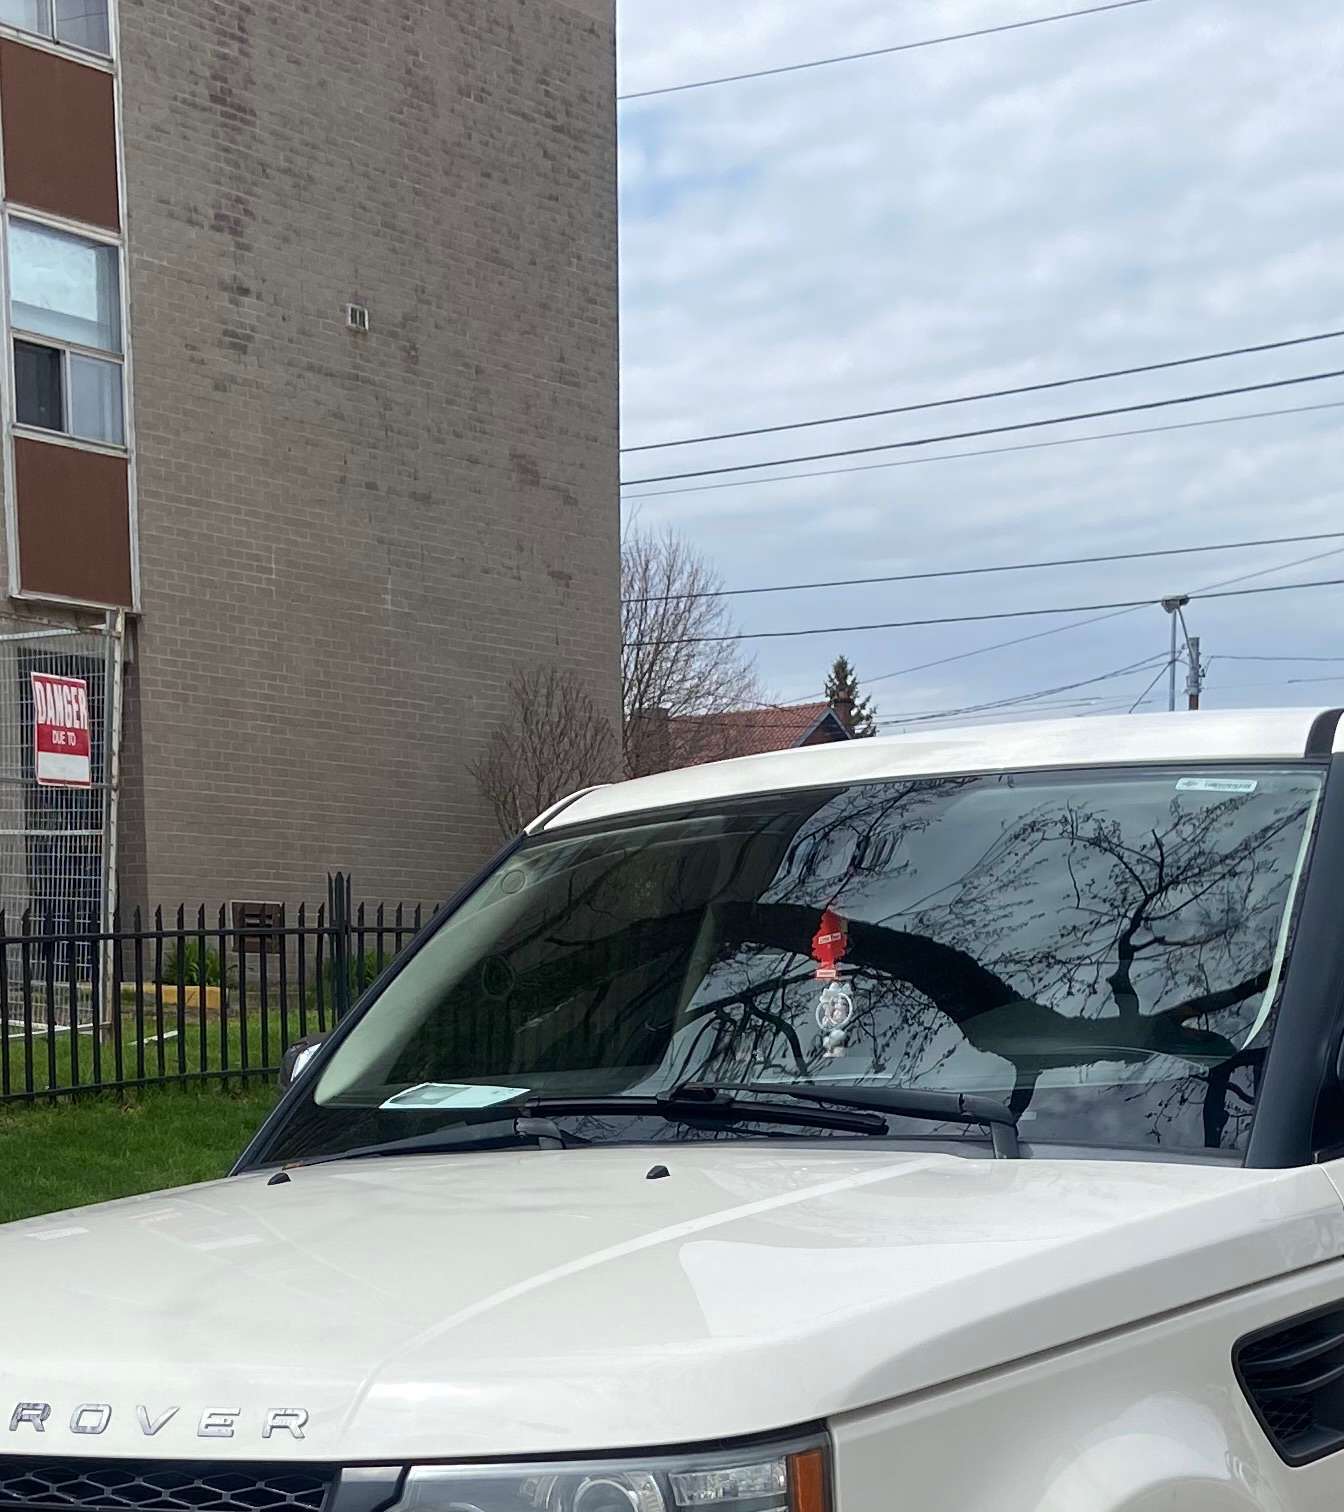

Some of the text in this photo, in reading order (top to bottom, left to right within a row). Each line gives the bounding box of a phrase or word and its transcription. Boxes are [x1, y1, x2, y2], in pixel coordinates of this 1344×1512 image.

[34, 681, 88, 730] DANGER
[52, 730, 76, 746] DUE TO
[8, 1401, 311, 1440] ROVER
